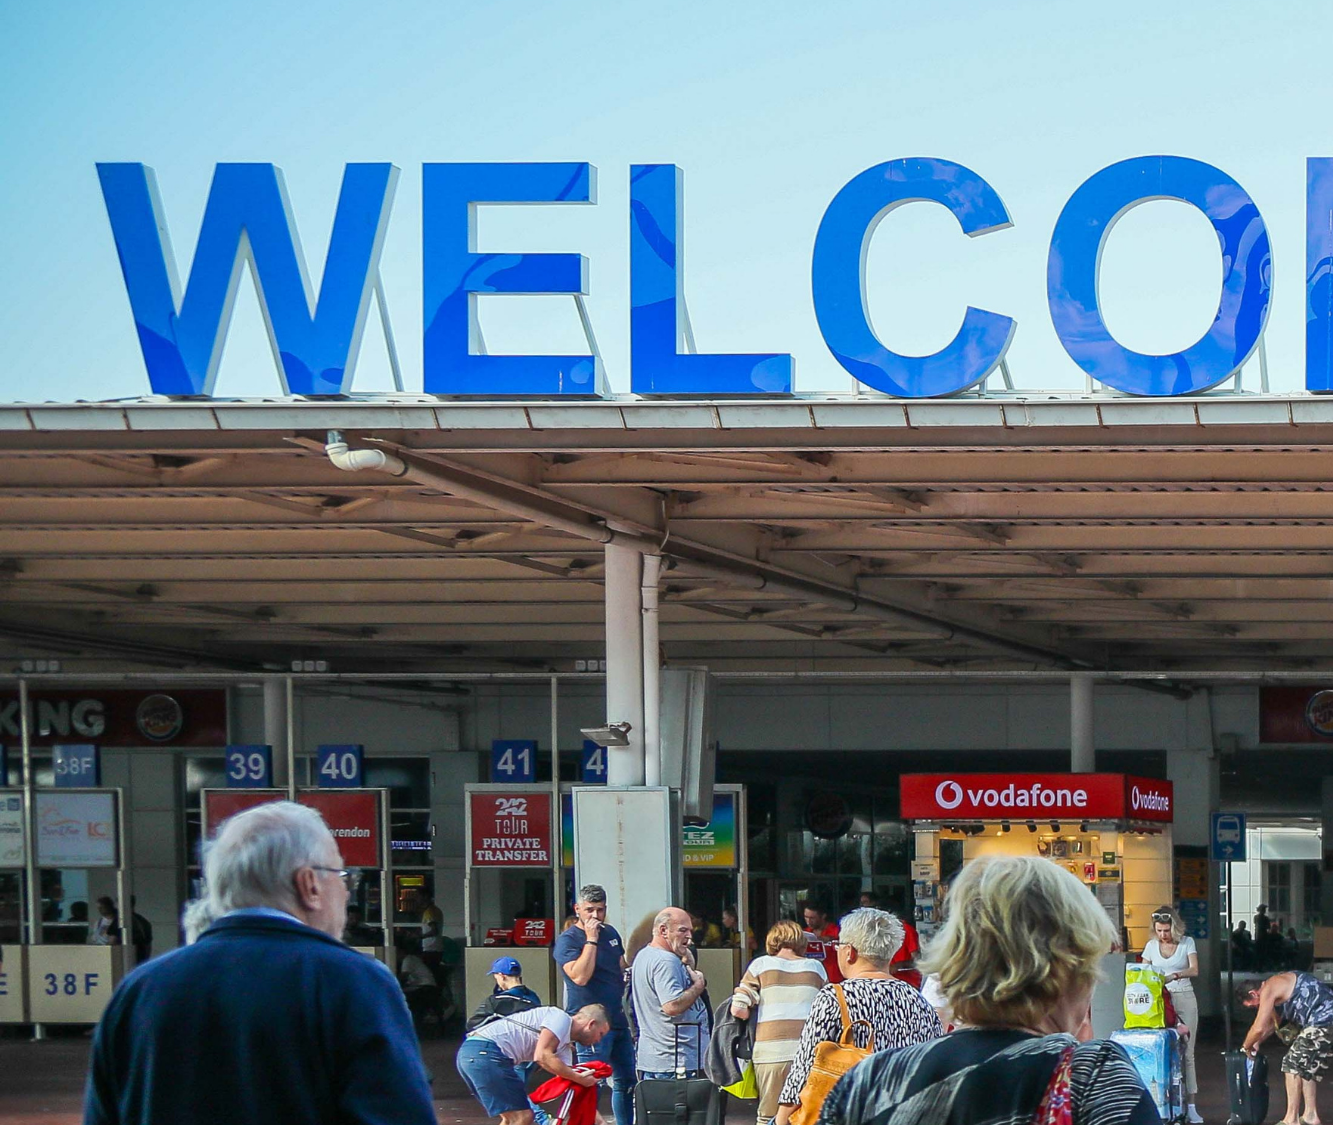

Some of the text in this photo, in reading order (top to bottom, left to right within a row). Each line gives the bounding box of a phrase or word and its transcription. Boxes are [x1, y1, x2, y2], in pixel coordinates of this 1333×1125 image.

[57, 757, 92, 775] 38F
[230, 753, 265, 780] 39
[321, 753, 357, 779] 40
[497, 749, 531, 775] 41
[586, 754, 608, 775] 4
[967, 783, 1087, 808] vodafone
[1139, 790, 1169, 811] vodafone
[495, 798, 528, 816] 242
[329, 824, 370, 838] orendon
[495, 816, 528, 834] TOUR
[482, 838, 541, 849] PRIVATE
[476, 850, 548, 861] TRANSFER
[44, 973, 98, 995] 38F
